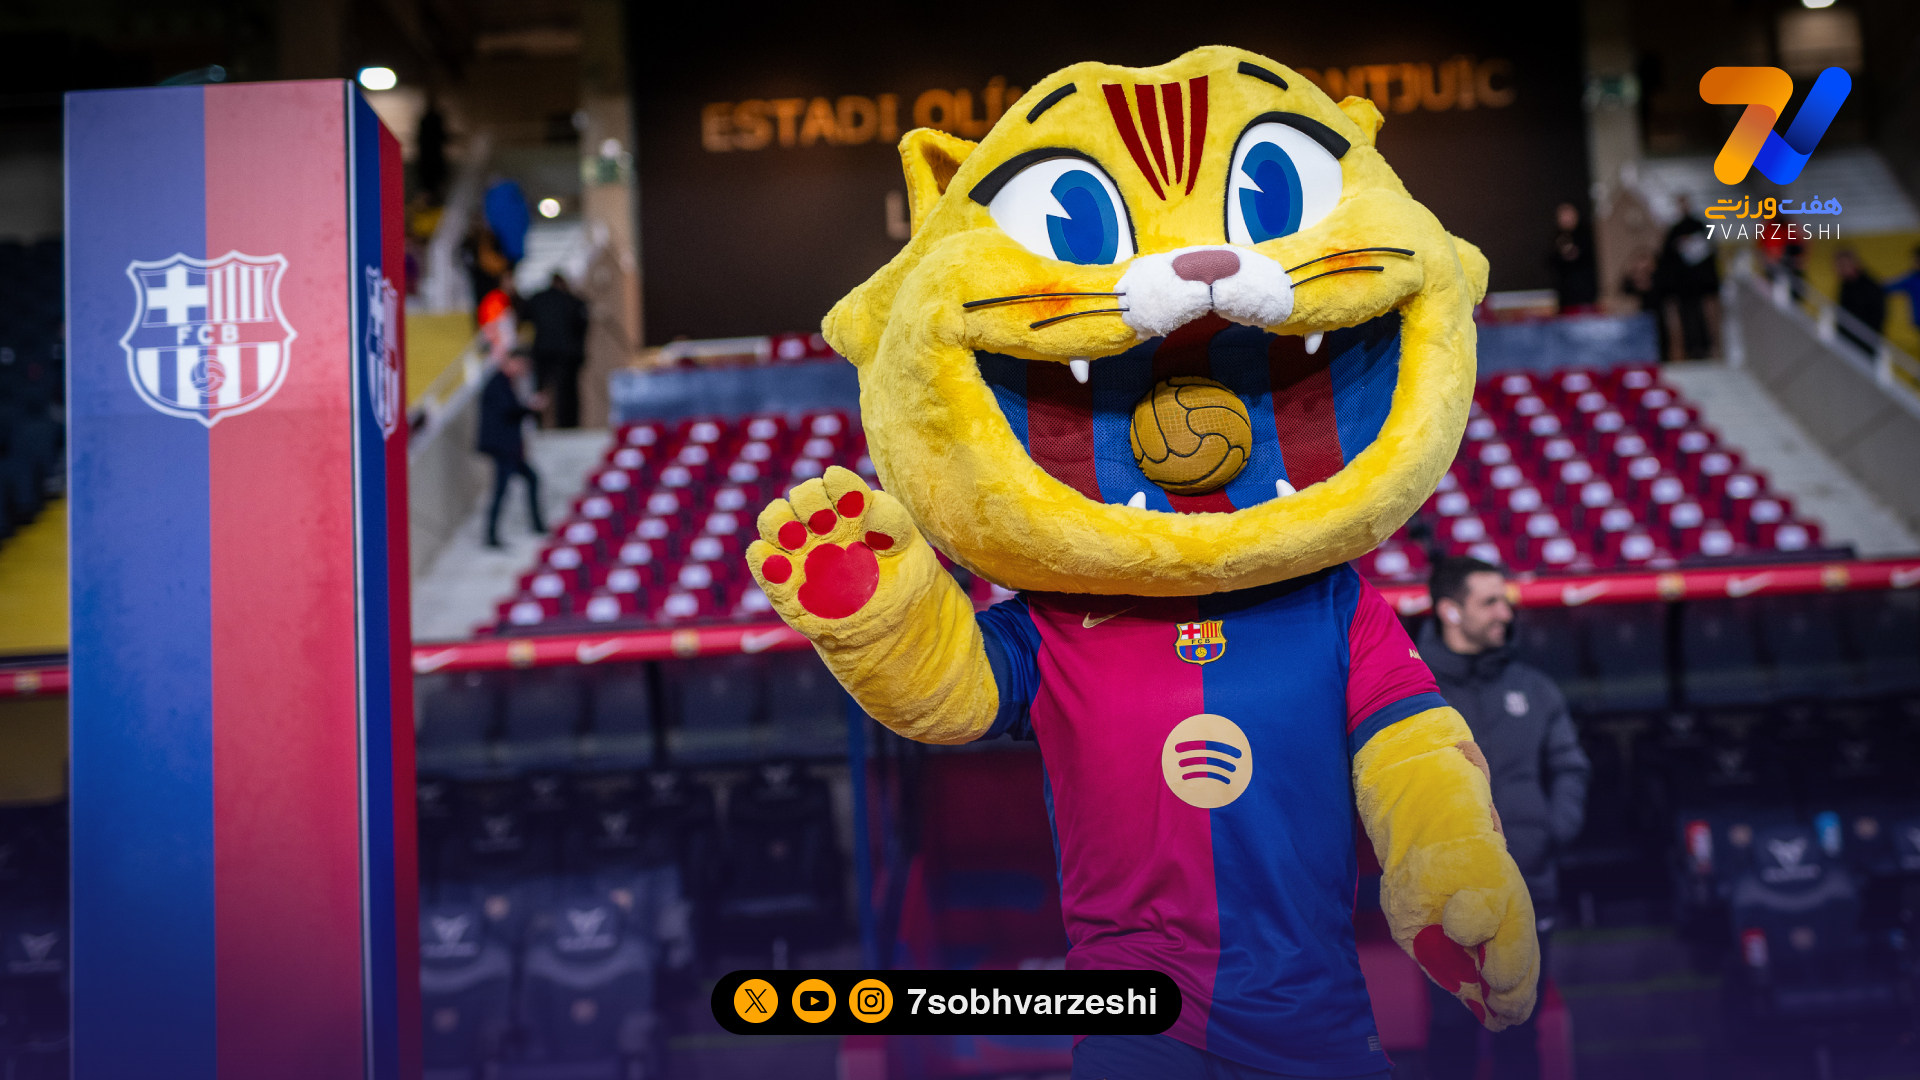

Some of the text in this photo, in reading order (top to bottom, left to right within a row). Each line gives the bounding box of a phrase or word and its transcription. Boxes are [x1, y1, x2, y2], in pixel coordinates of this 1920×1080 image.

[702, 93, 898, 151] ESTADI
[913, 76, 1024, 138] OLÍ
[177, 324, 239, 345] FCB
